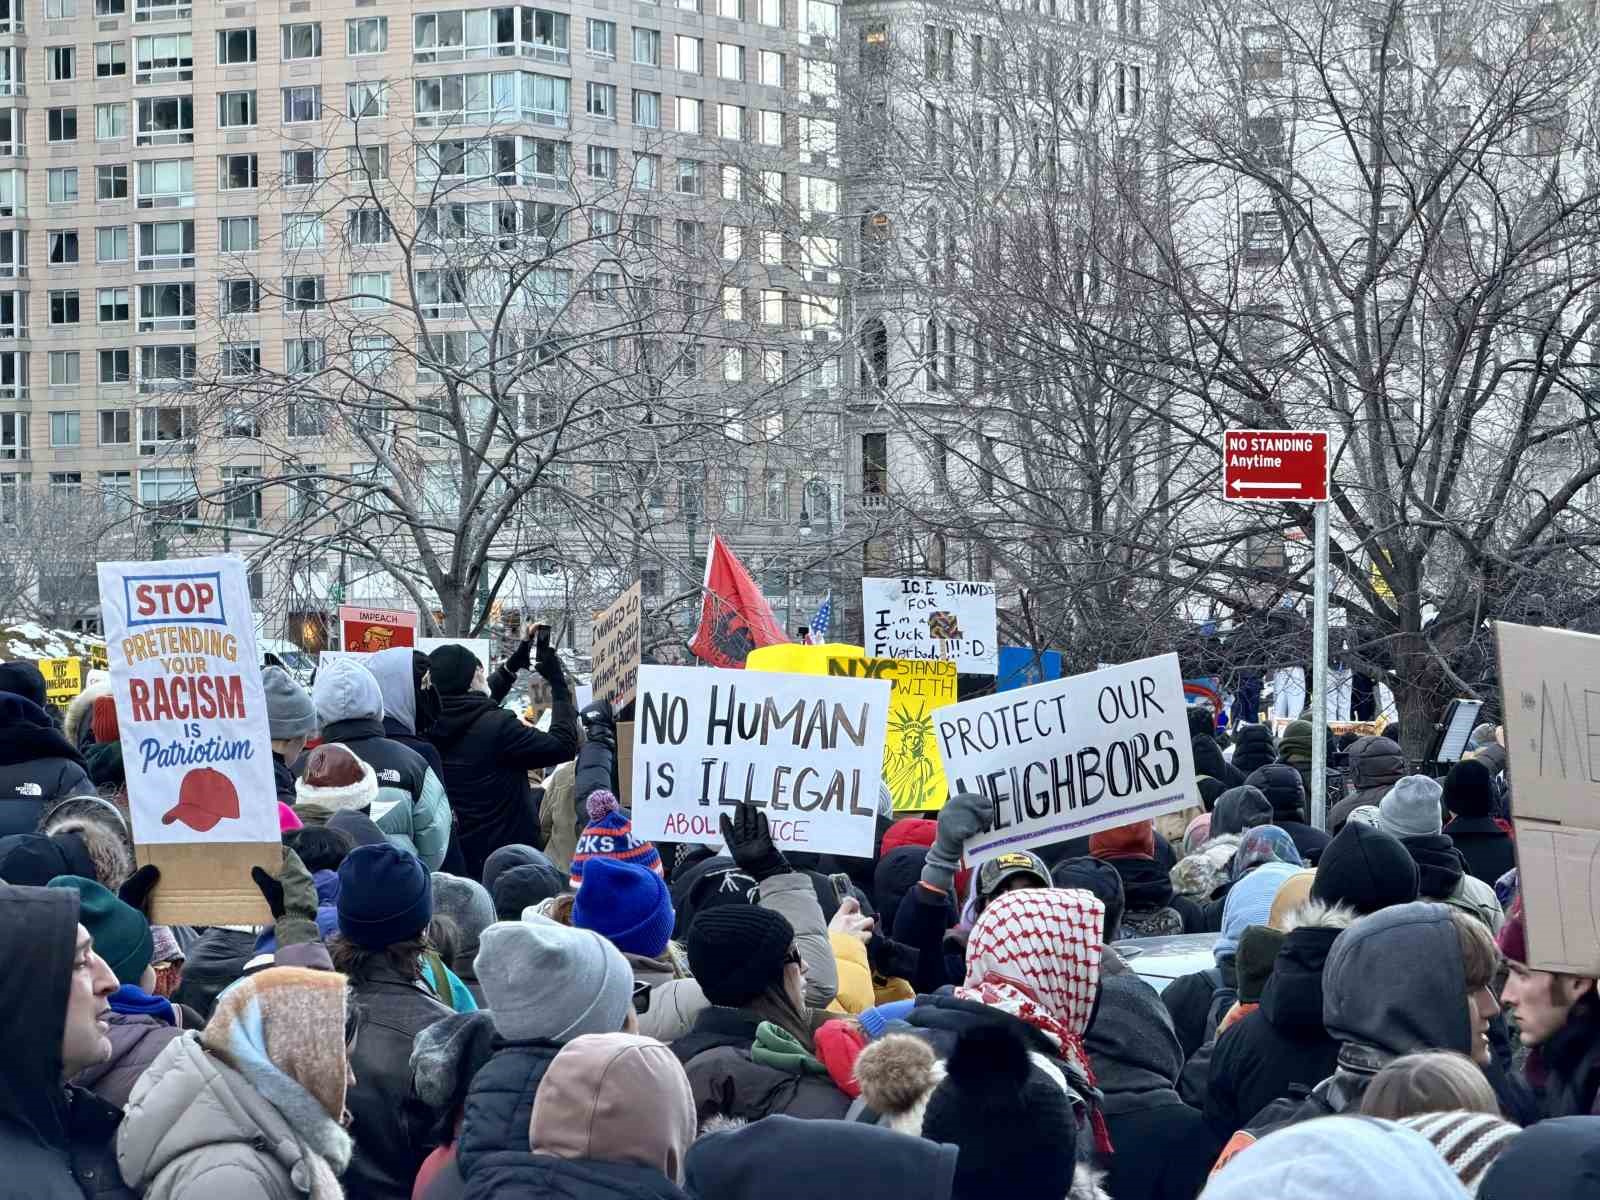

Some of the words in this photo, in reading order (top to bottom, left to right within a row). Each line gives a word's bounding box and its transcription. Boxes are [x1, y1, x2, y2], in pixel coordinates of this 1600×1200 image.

[1229, 438, 1248, 451] NO
[1251, 438, 1313, 452] STANDING
[1230, 454, 1282, 470] Anytime
[135, 582, 214, 616] STOP
[945, 581, 995, 597] STANDS
[908, 598, 939, 611] FOR
[359, 612, 398, 625] IMPEACH
[122, 626, 238, 667] PRETENDING
[160, 656, 207, 675] YOUR
[897, 660, 957, 677] STANDS
[129, 675, 247, 722] RACISM
[897, 677, 954, 699] WITH
[640, 690, 689, 746] NO
[706, 684, 870, 750] HUMAN
[940, 694, 1070, 760] PROTECT
[1097, 676, 1165, 725] OUR
[183, 723, 202, 738] IS
[139, 735, 255, 774] Patriotism
[644, 760, 675, 801] IS
[698, 757, 875, 818] ILLEGAL
[770, 819, 811, 842] ICE
